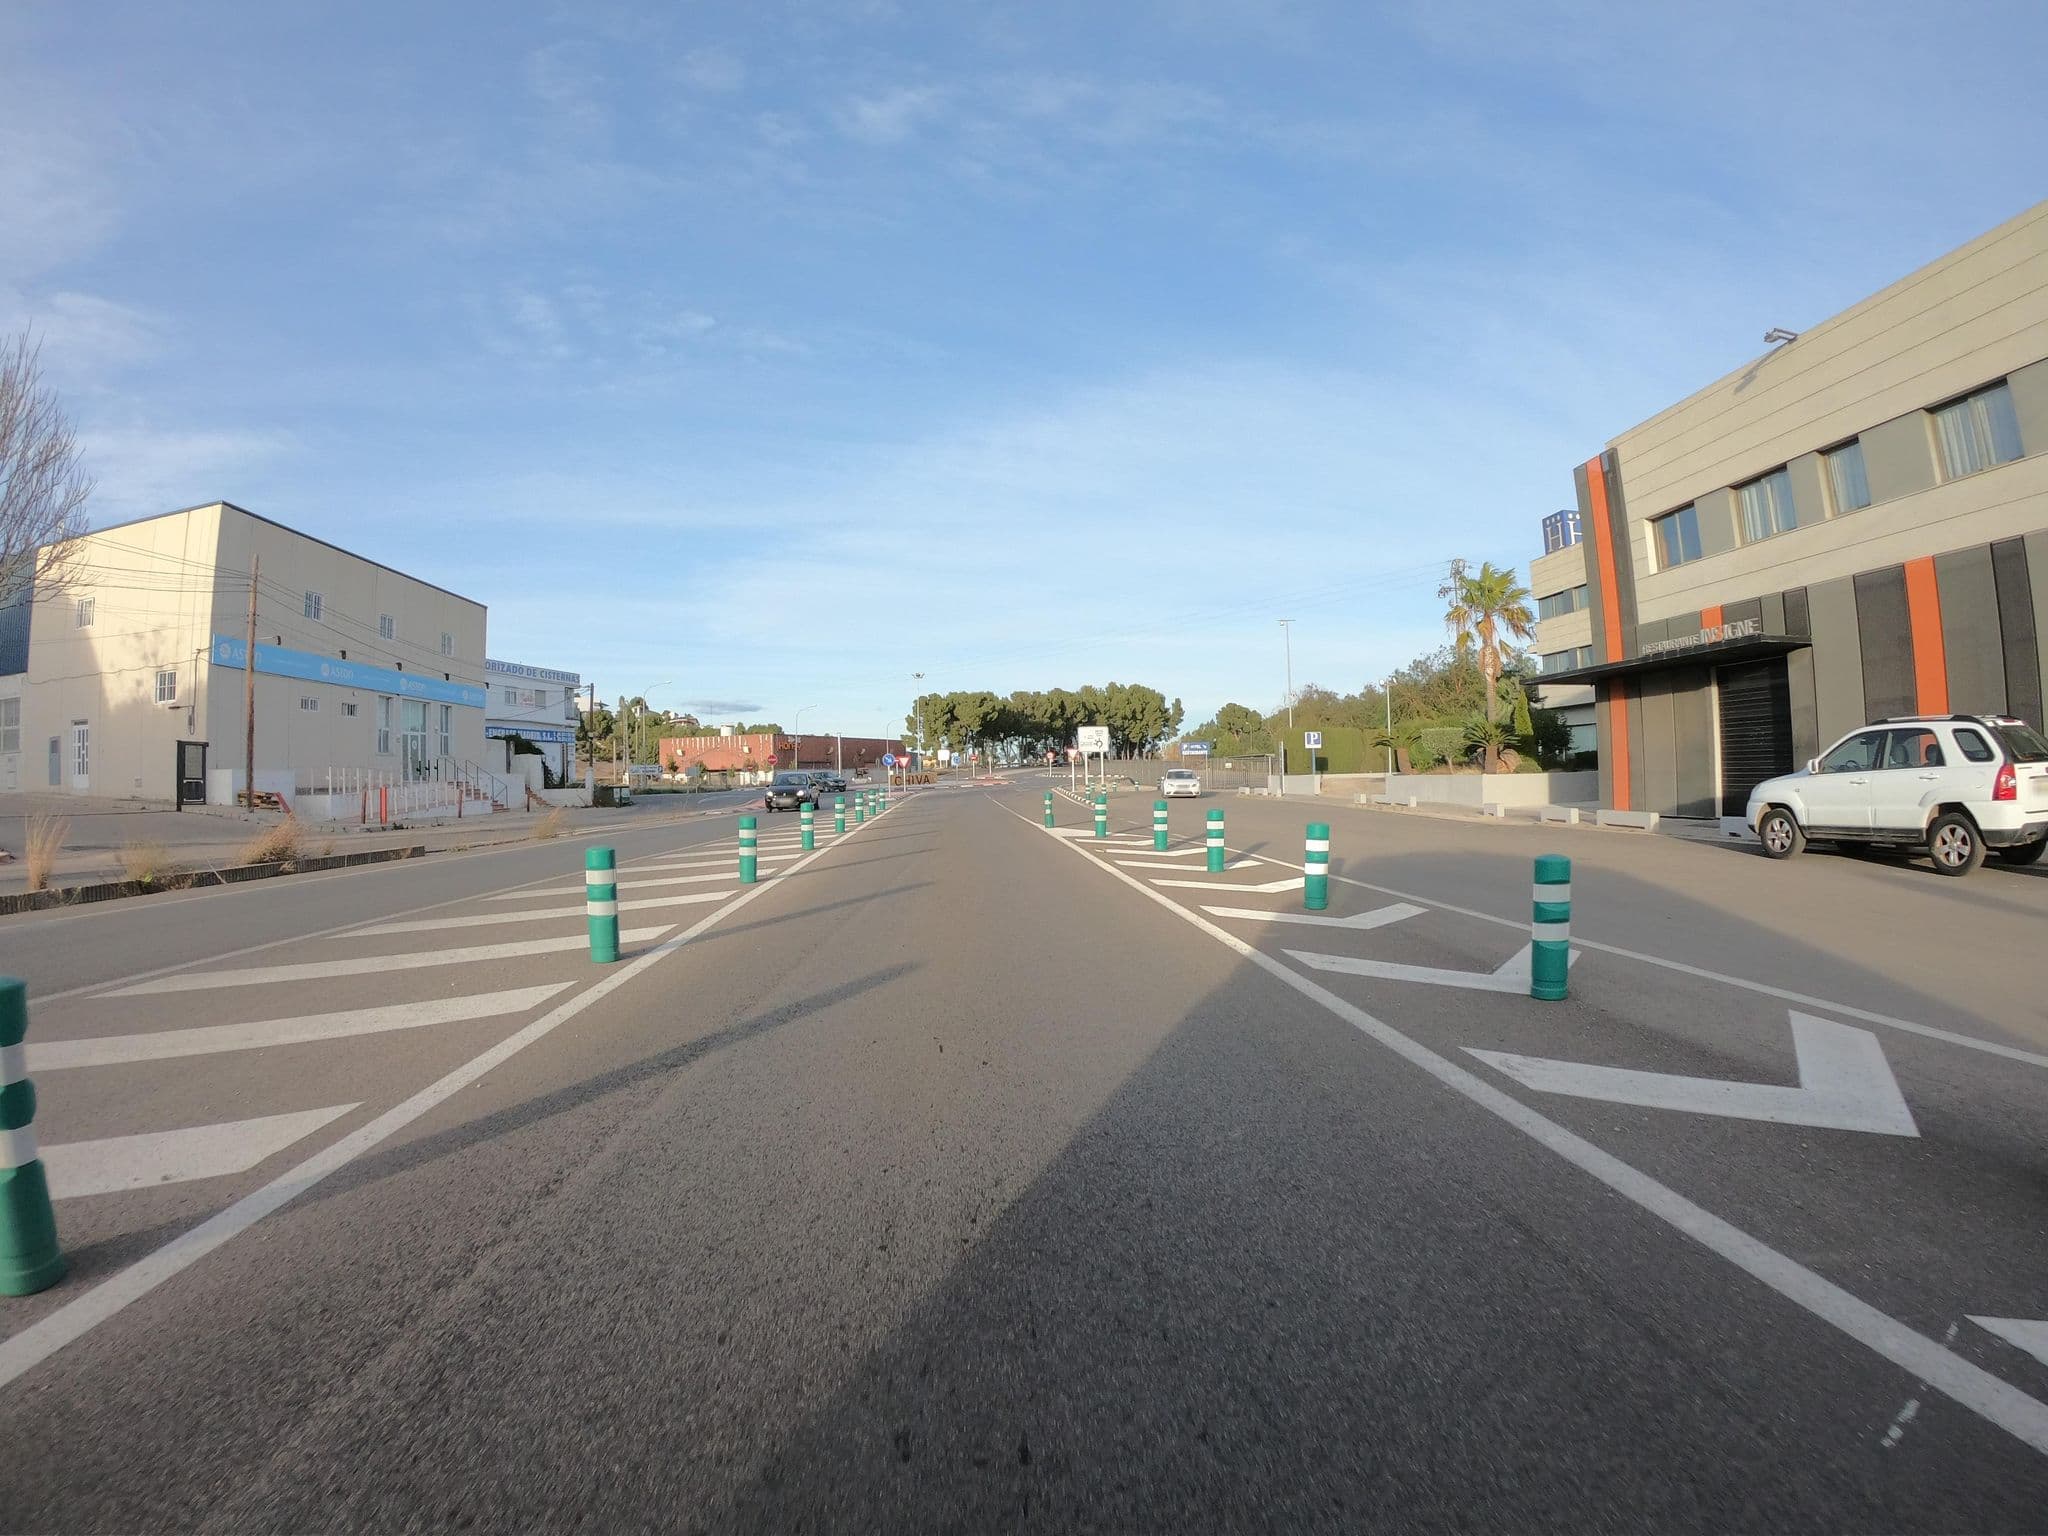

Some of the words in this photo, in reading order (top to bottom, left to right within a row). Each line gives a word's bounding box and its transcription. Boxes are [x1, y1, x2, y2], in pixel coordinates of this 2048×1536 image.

[526, 668, 537, 678] DE
[540, 670, 580, 684] CISTERNAS
[894, 774, 931, 787] CHIVA
